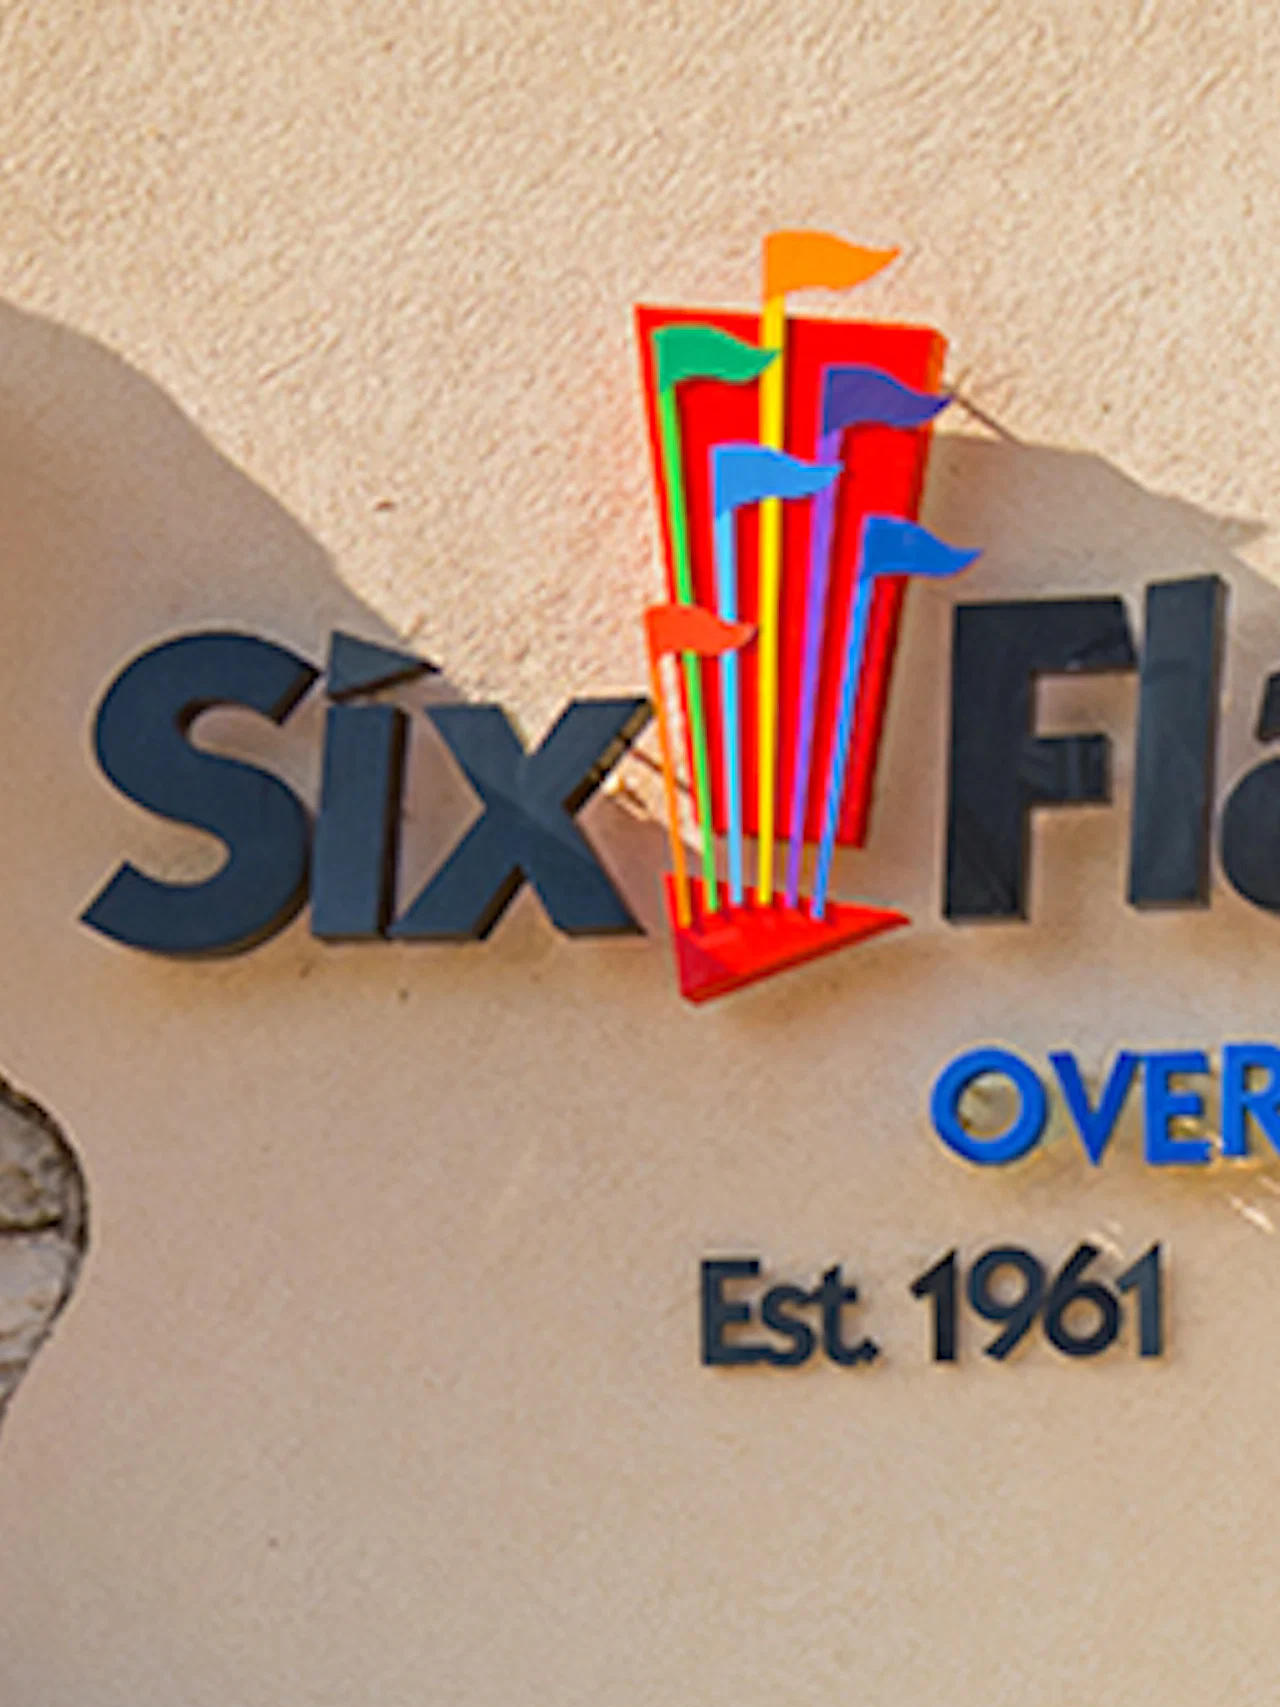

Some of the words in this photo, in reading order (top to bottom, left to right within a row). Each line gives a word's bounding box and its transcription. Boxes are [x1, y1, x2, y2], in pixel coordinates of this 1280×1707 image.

[80, 630, 653, 960] Six
[699, 1258, 880, 1368] Est.
[909, 1243, 1164, 1363] 1961
